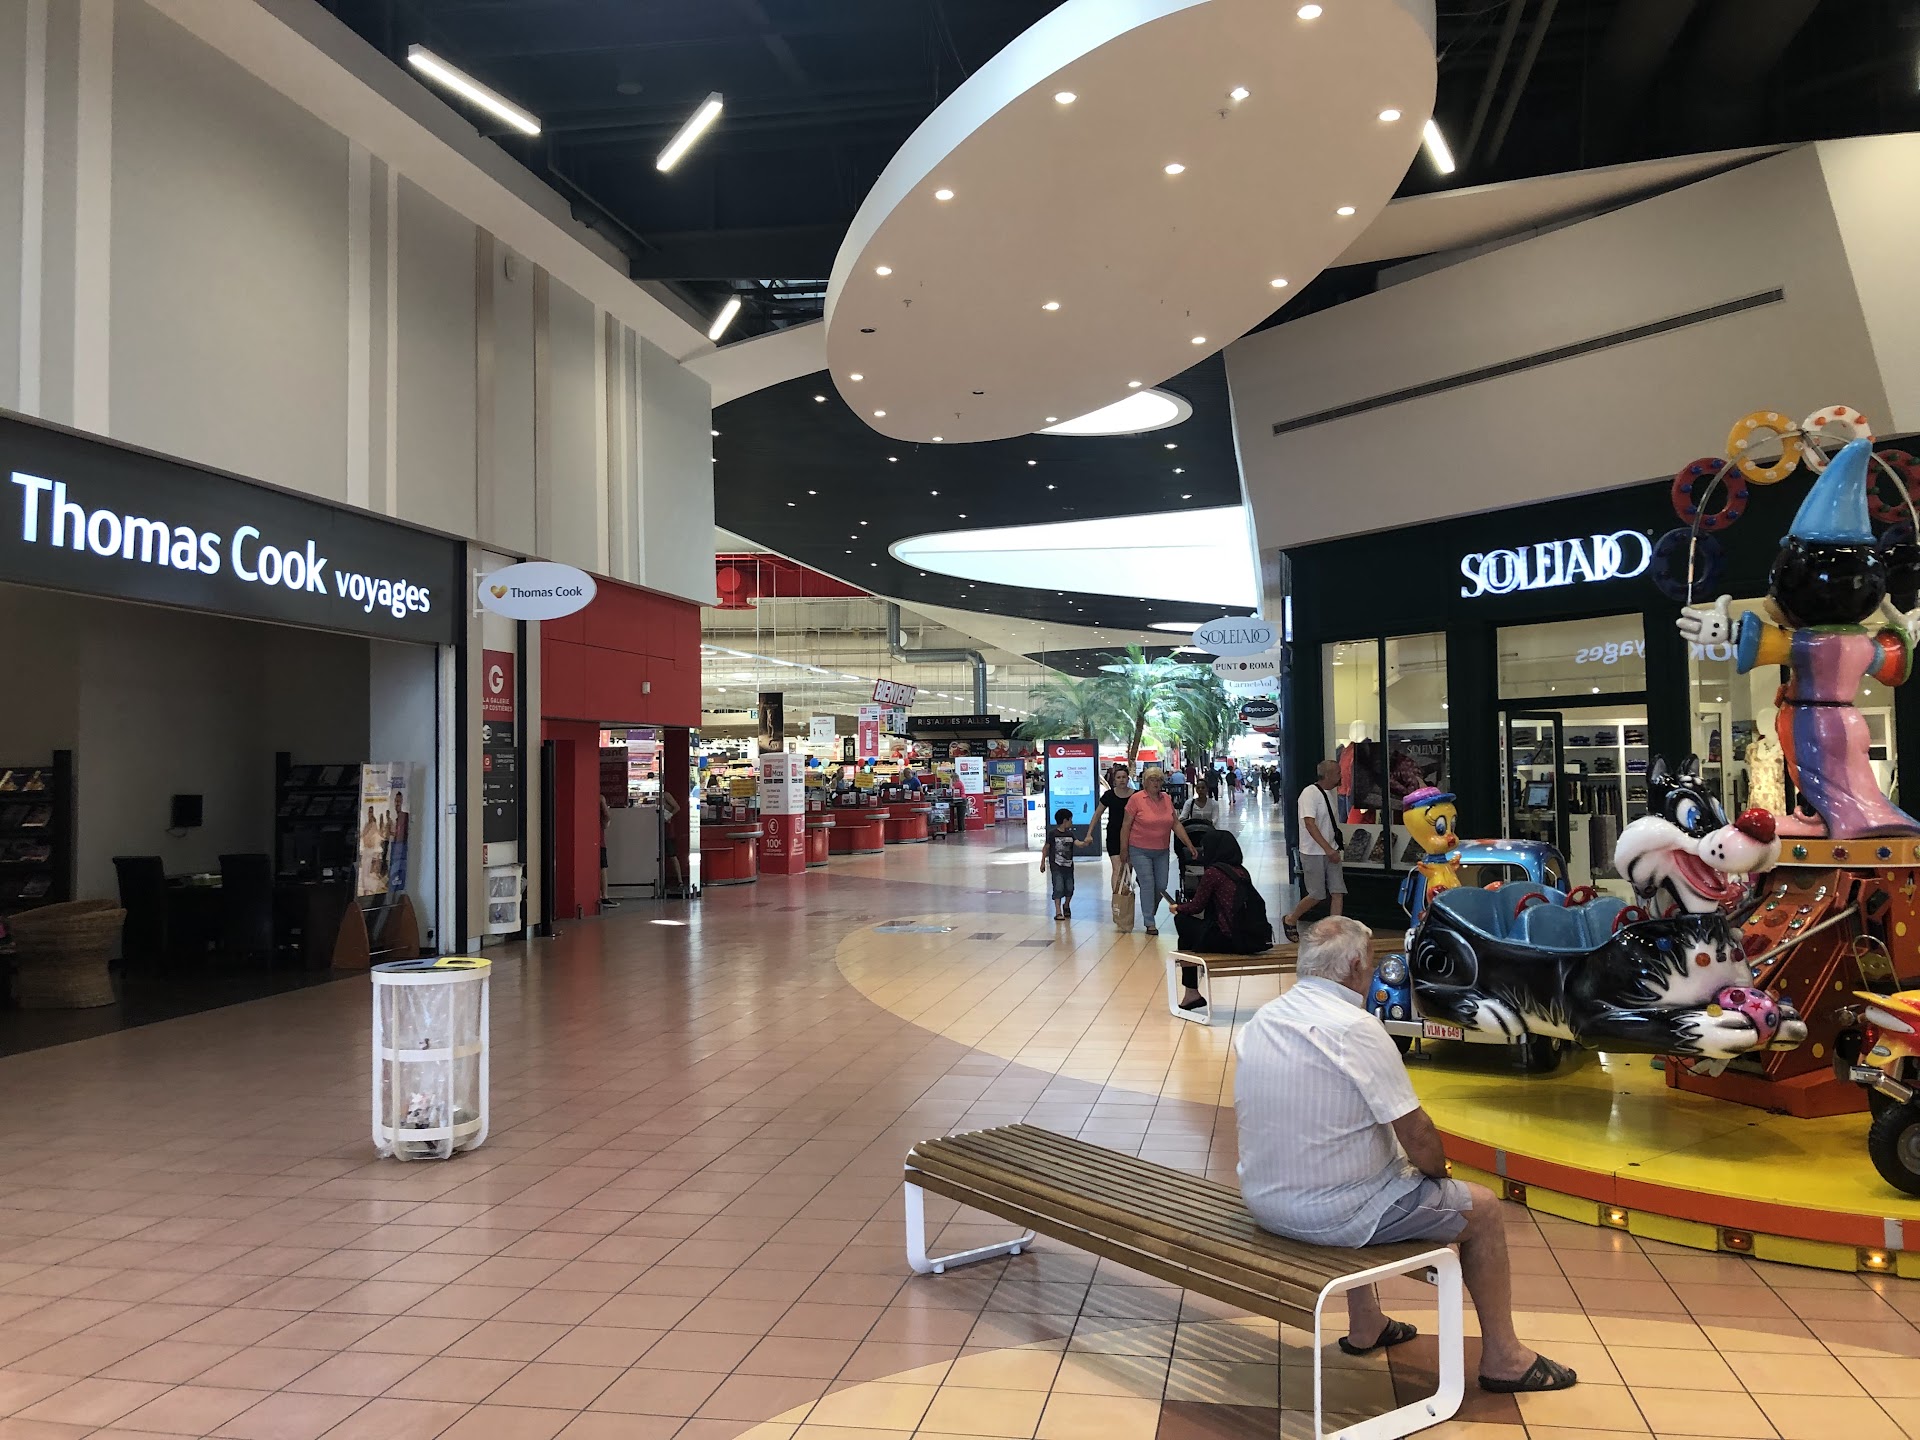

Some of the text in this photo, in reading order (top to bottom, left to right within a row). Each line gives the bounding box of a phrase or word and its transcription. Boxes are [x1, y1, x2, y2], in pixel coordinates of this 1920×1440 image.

[11, 471, 431, 619] Thomas Cook voyages
[510, 586, 583, 598] Thomas Cook
[488, 664, 504, 694] G
[1426, 1024, 1460, 1038] VLM 649
